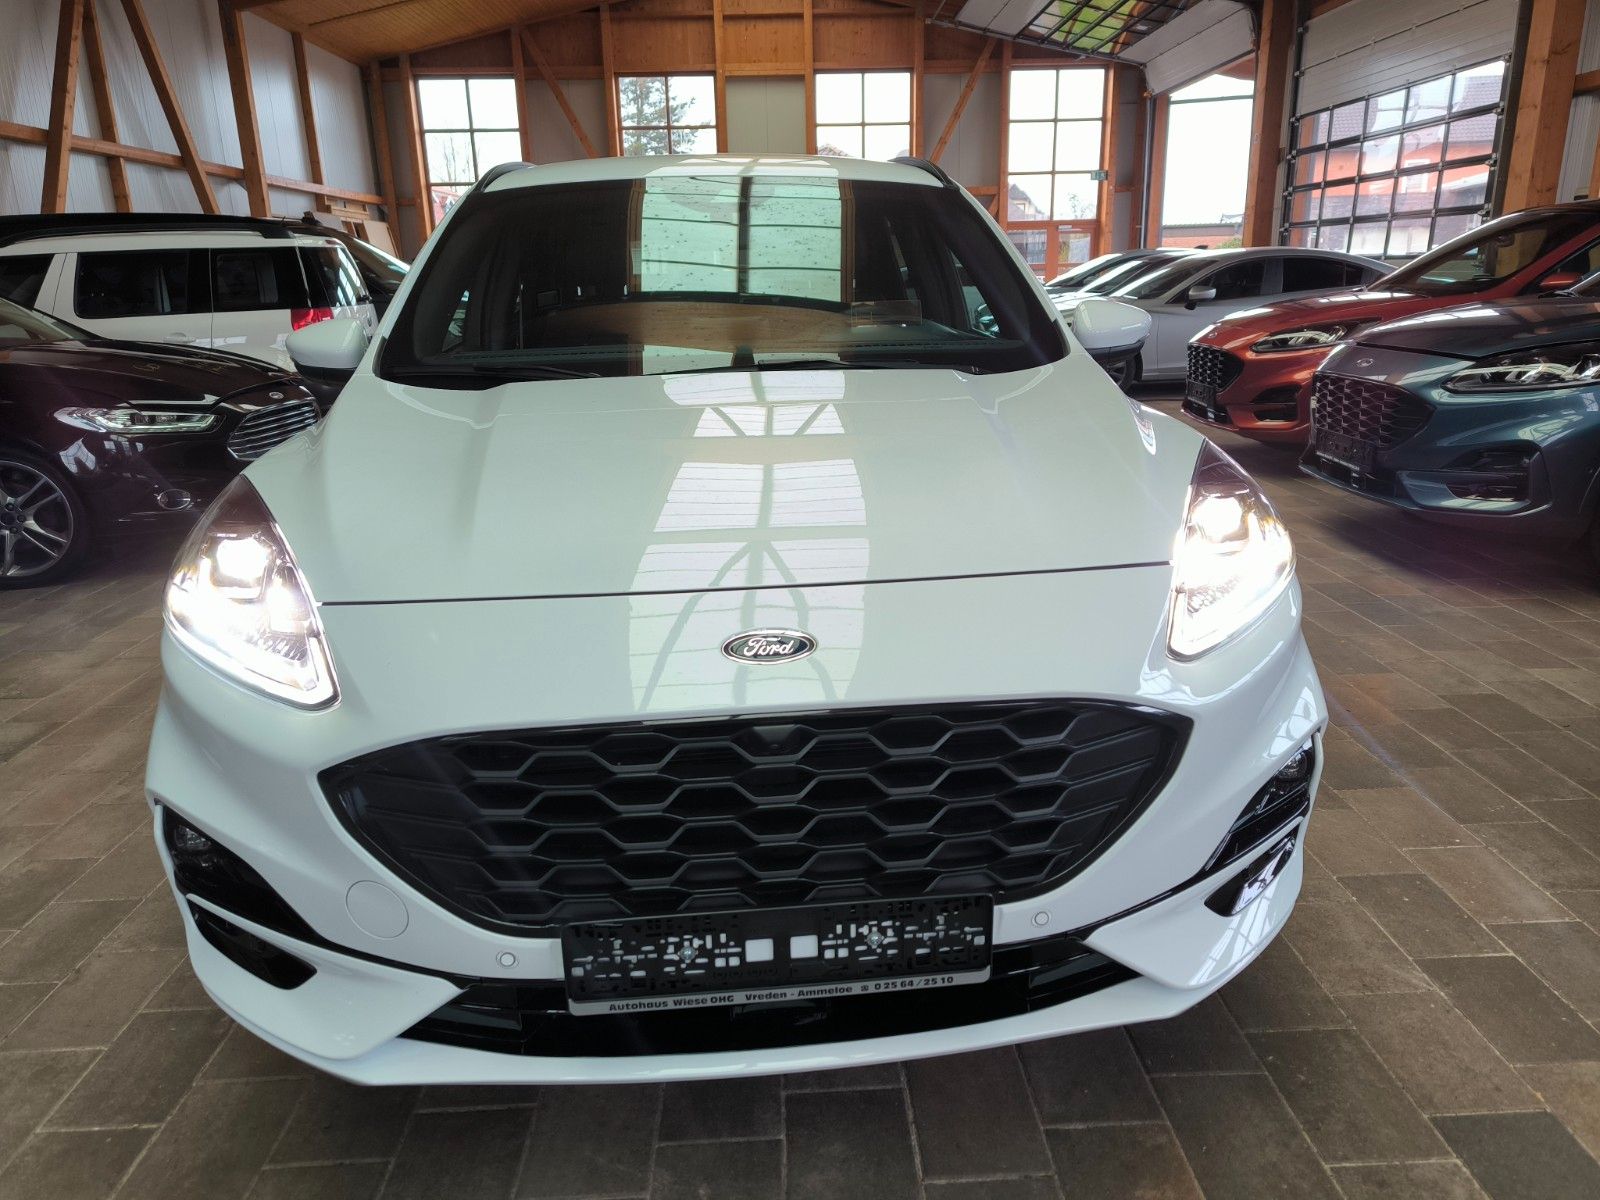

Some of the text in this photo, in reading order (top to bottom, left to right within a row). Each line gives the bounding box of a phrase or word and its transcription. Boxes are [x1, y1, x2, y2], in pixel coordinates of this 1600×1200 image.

[743, 637, 795, 657] Ford
[609, 1001, 669, 1012] Autohaus
[673, 998, 708, 1007] Wiese
[710, 995, 734, 1004] OHG
[745, 992, 788, 1001] Vreden
[797, 986, 853, 998] Ammeloe
